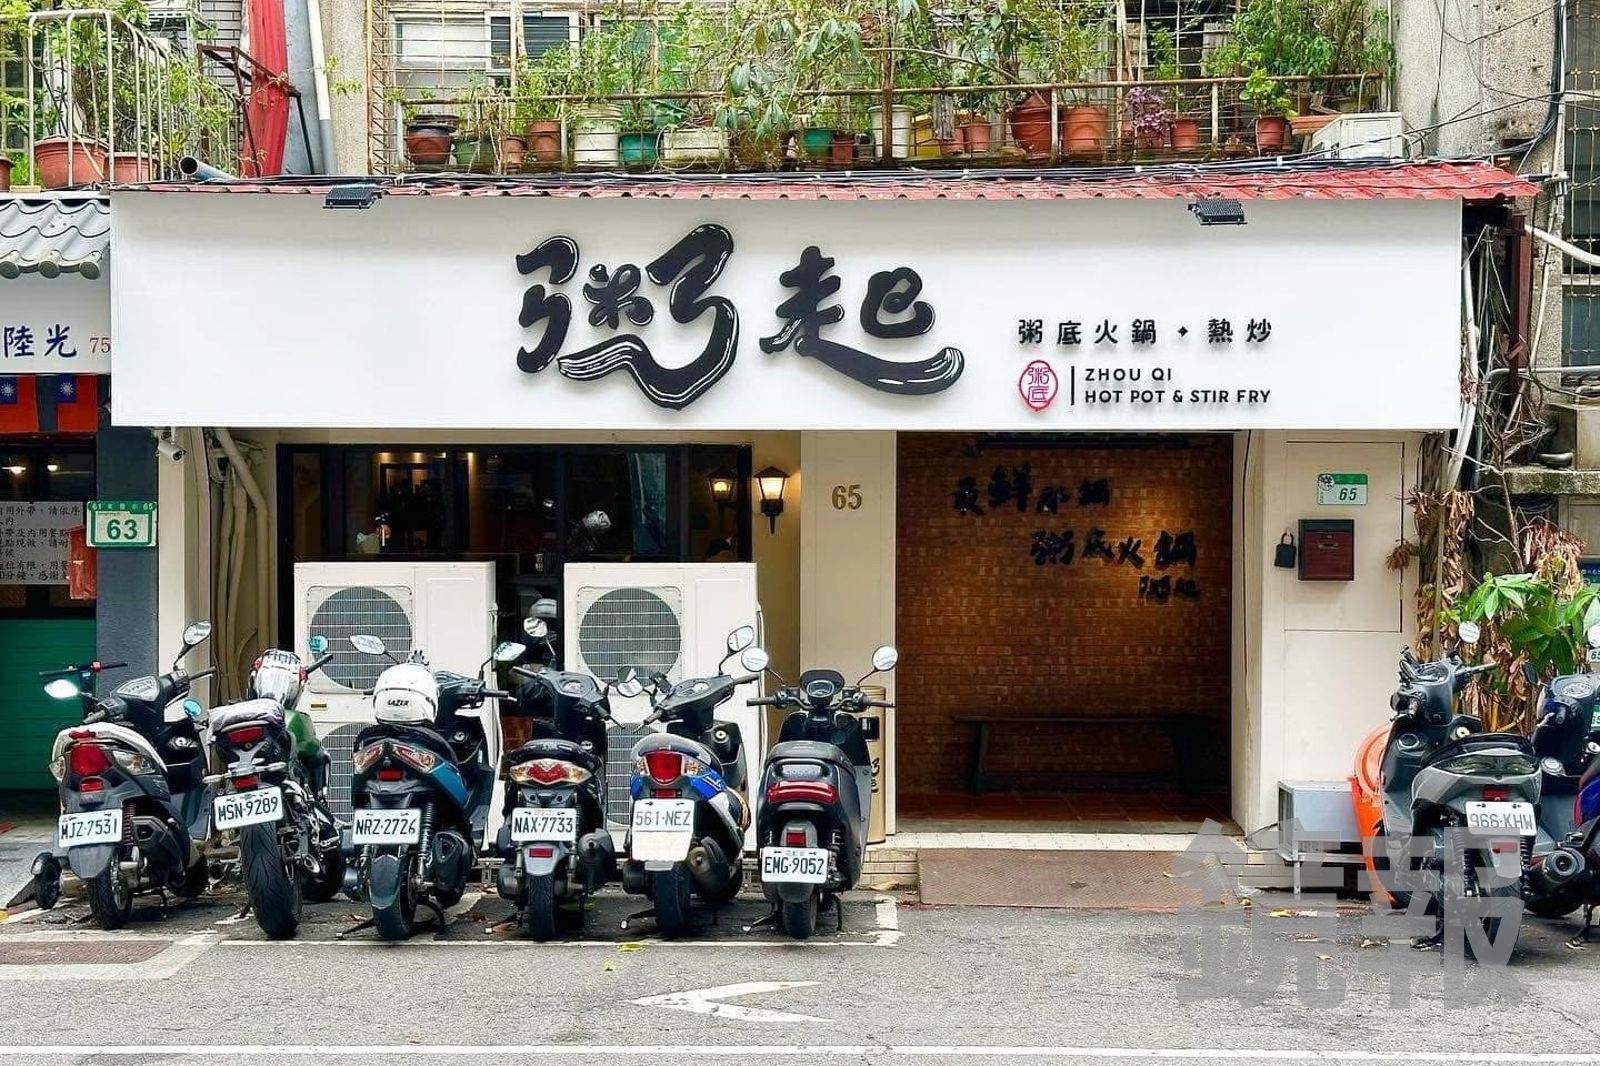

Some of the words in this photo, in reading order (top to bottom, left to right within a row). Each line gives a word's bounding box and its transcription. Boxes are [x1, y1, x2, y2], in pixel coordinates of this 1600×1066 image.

[516, 223, 965, 411] 粥起
[3, 324, 78, 359] 陸光
[1027, 367, 1050, 403] 粥底
[1084, 368, 1141, 382] ZHOU
[1151, 367, 1172, 383] QI
[1084, 390, 1123, 404] HOT
[1130, 390, 1166, 404] POT
[1173, 390, 1183, 404] &
[1190, 390, 1229, 404] STIR
[1237, 390, 1271, 404] FRY
[831, 484, 863, 511] 65
[1339, 487, 1358, 501] 65
[107, 518, 138, 541] 63
